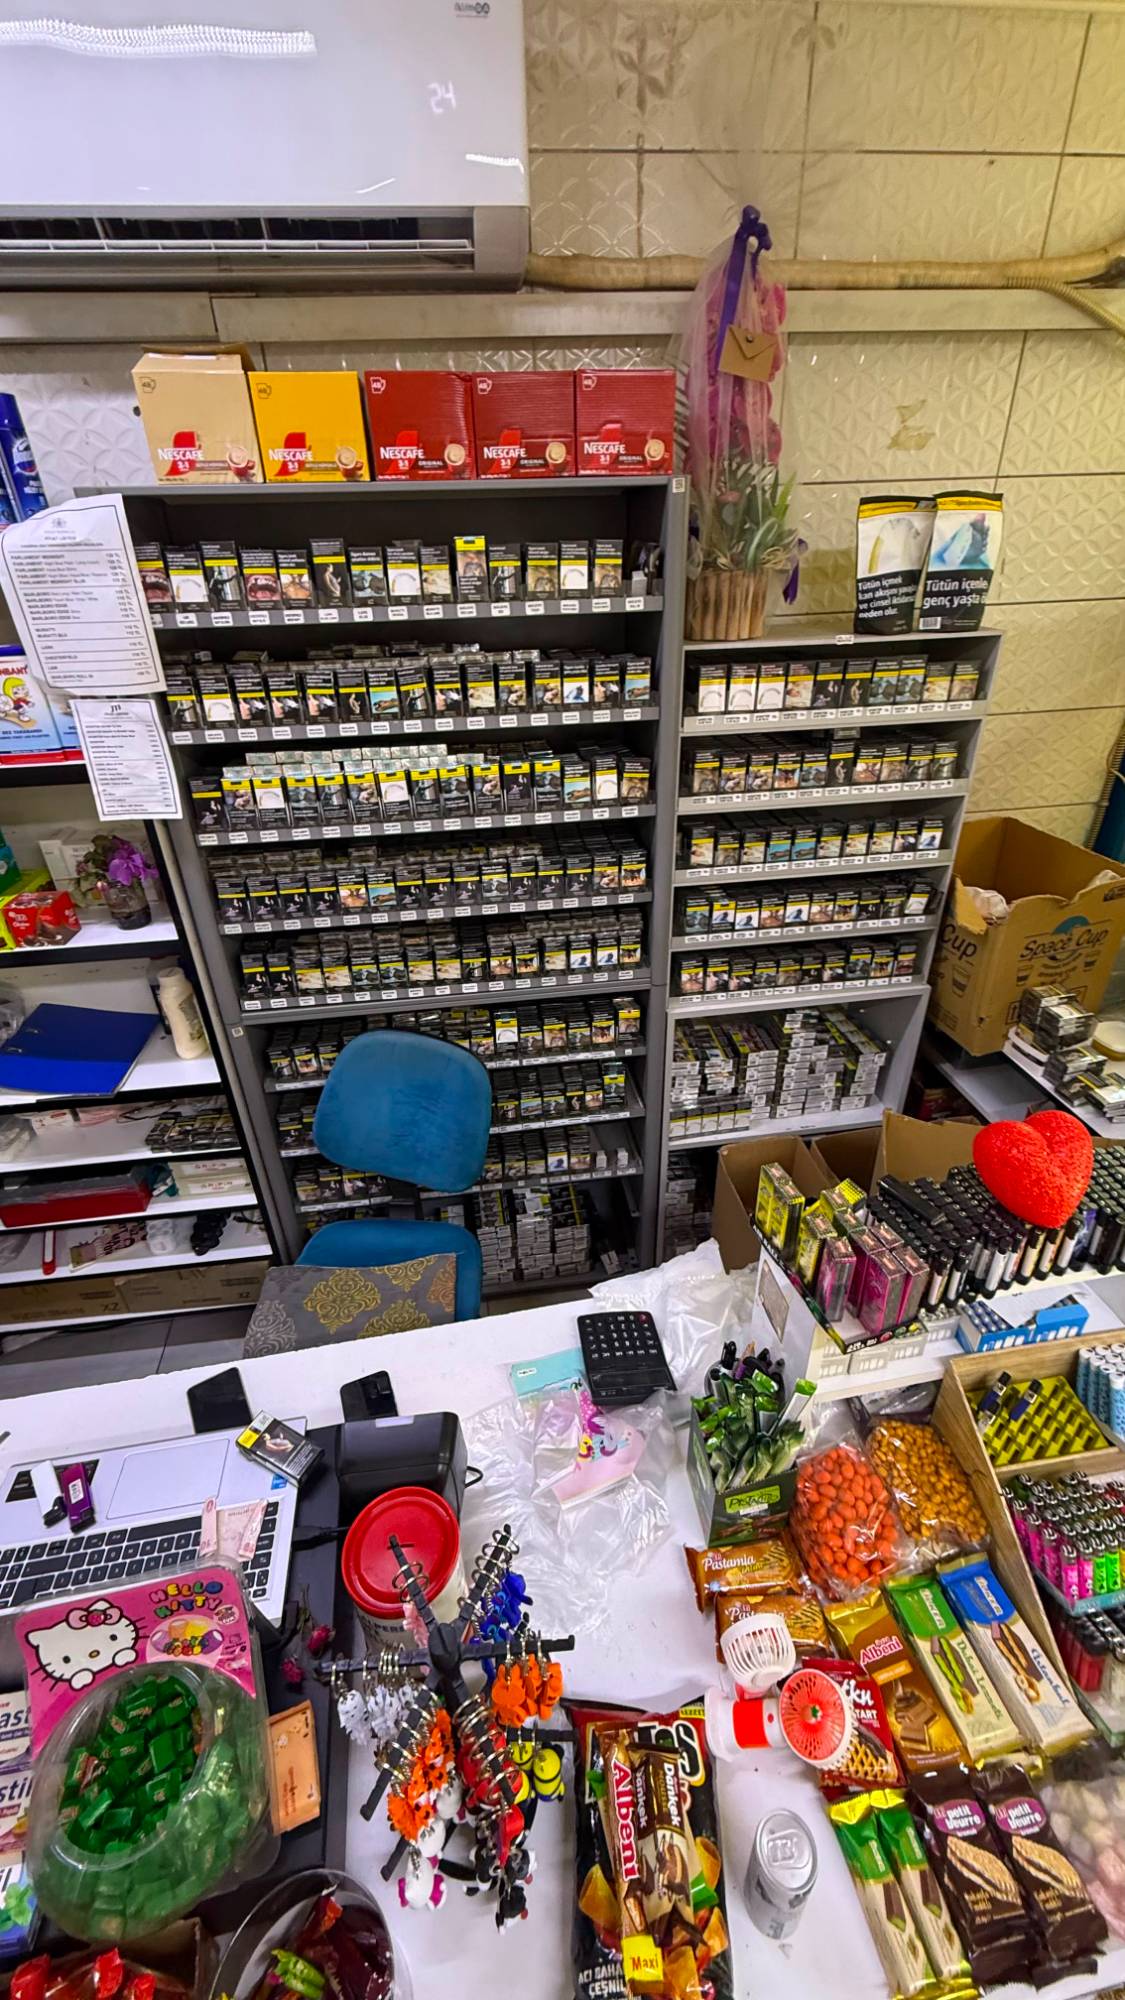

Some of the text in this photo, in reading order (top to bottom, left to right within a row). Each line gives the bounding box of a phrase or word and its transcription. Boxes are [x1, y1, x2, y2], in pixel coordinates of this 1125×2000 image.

[427, 81, 456, 113] 24
[926, 579, 960, 592] Tütün
[923, 595, 952, 609] genç
[940, 923, 977, 961] Cup
[1075, 928, 1110, 948] Cup
[149, 1580, 224, 1604] HELLO
[154, 1595, 222, 1618] KITTY
[861, 1635, 904, 1666] Albeni
[663, 1762, 681, 1828] Dankek
[611, 1757, 640, 1882] Albeni
[945, 1804, 971, 1822] petit
[1006, 1810, 1043, 1829] beurre
[1007, 1802, 1033, 1820] petit
[630, 1954, 660, 1971] Maxi
[588, 1977, 628, 1999] ÇEŞNİL
